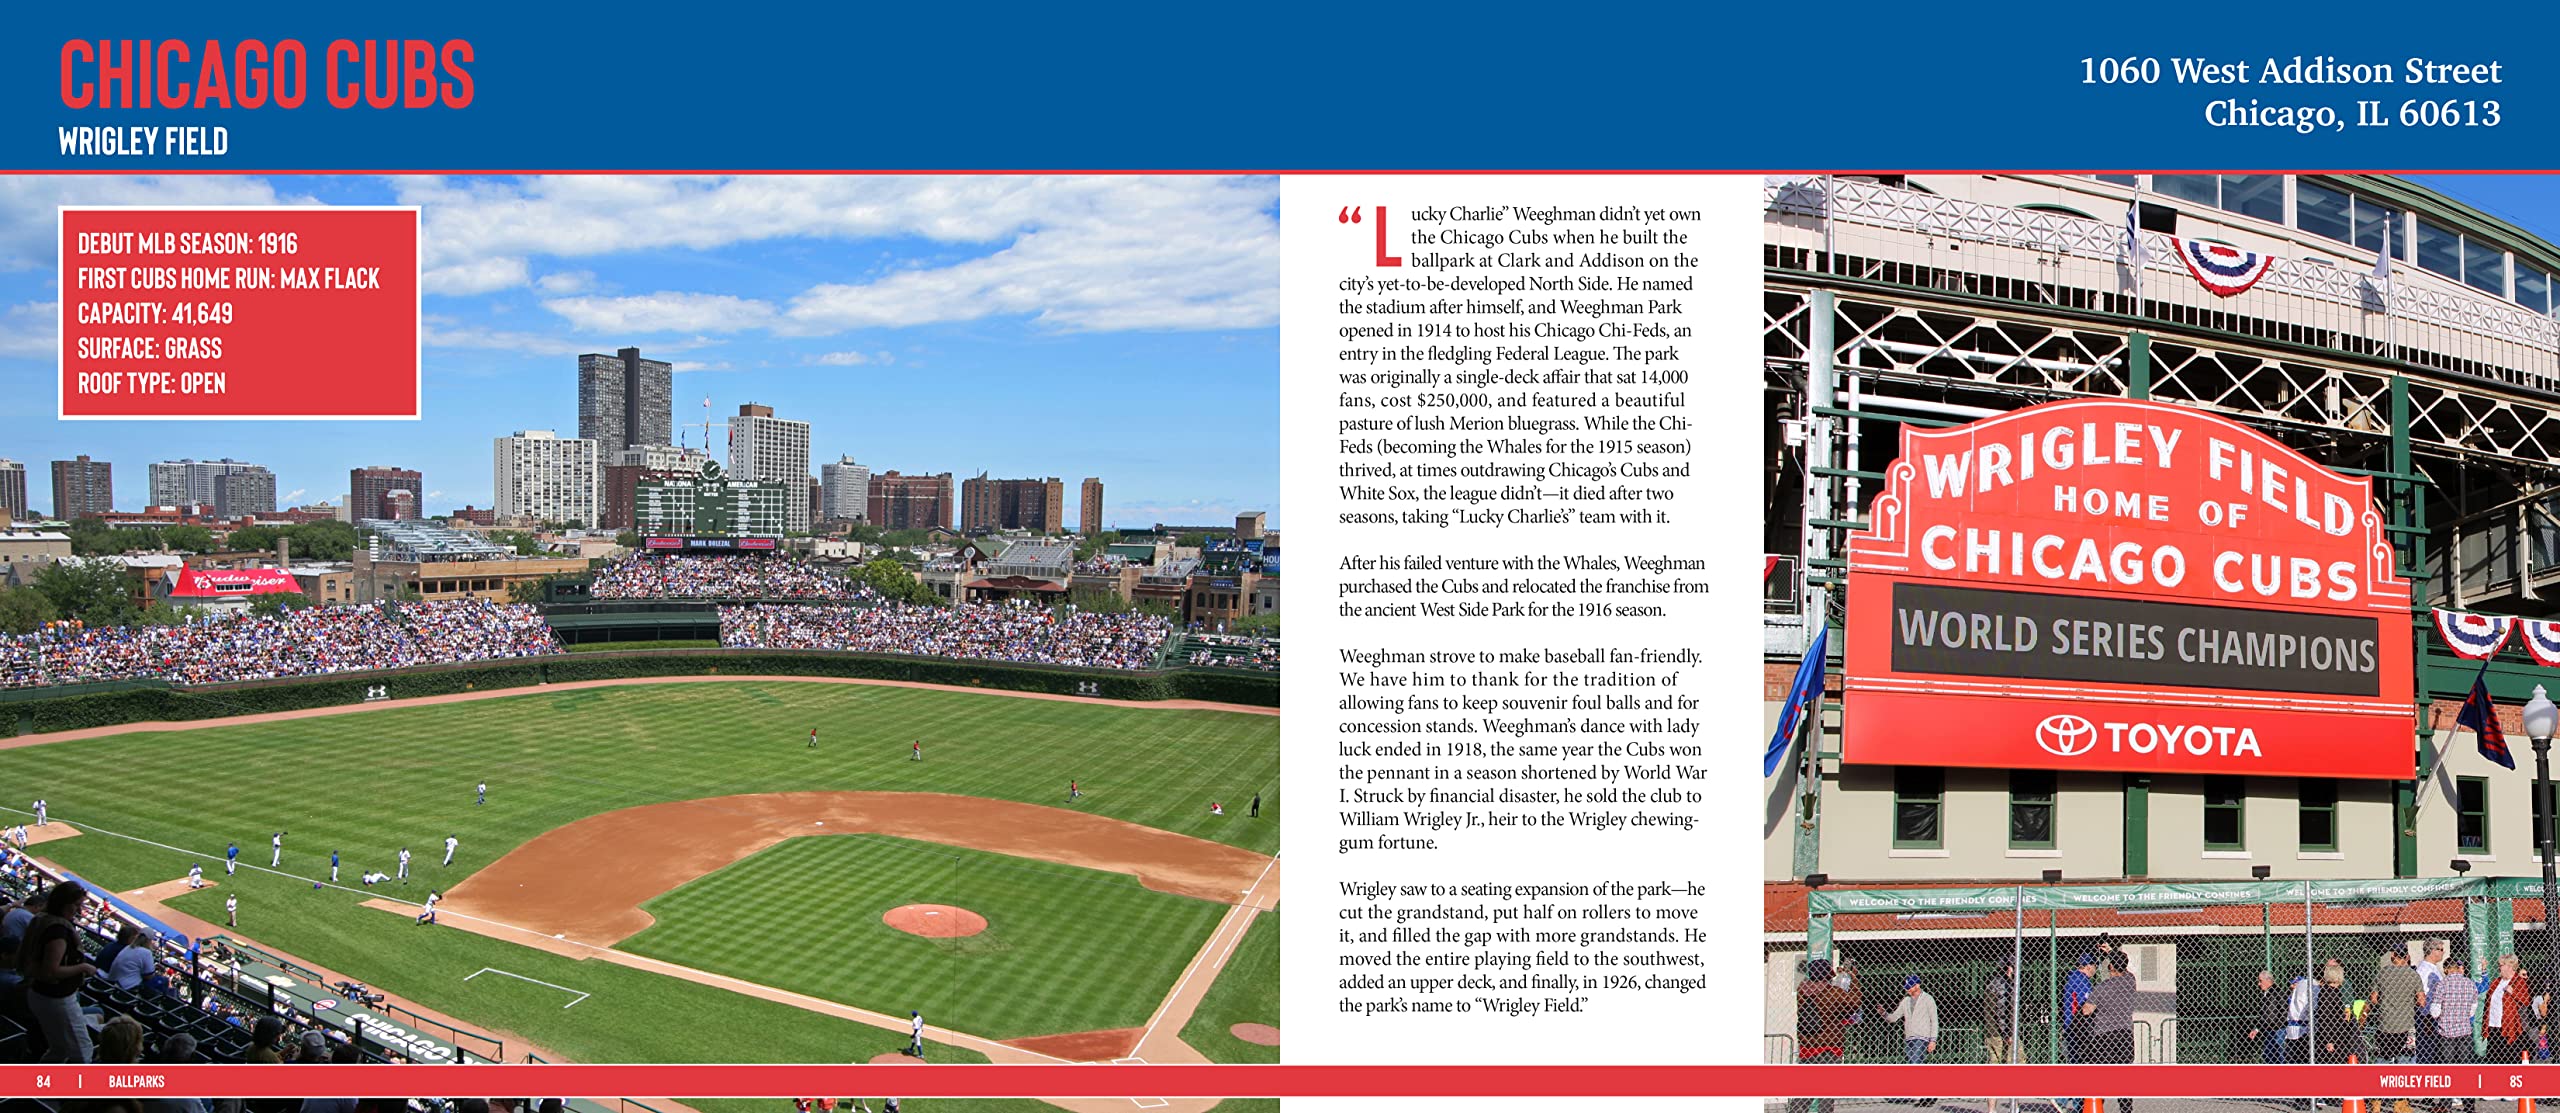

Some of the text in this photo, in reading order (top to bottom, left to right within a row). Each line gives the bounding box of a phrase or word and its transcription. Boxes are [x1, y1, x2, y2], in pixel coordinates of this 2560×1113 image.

[1923, 422, 2354, 536] WRIGLEY FIELD
[2055, 485, 2248, 528] HOME OF
[1922, 525, 2357, 601] CHICAGO CUBS
[1899, 608, 2375, 673] WORLD SERIES CHAMPIONS
[2104, 722, 2262, 757] TOYOTA
[1850, 898, 1899, 907] WELCOME
[1901, 898, 1915, 906] TO
[1918, 897, 1937, 906] THE
[1940, 896, 1985, 905] FRIENDLY
[2073, 890, 2251, 902] WELCOME TO THE FRIENDLY CONFINES
[2286, 887, 2330, 896] WELOME
[2333, 887, 2346, 896] TO
[2367, 885, 2408, 895] FRIENDLY
